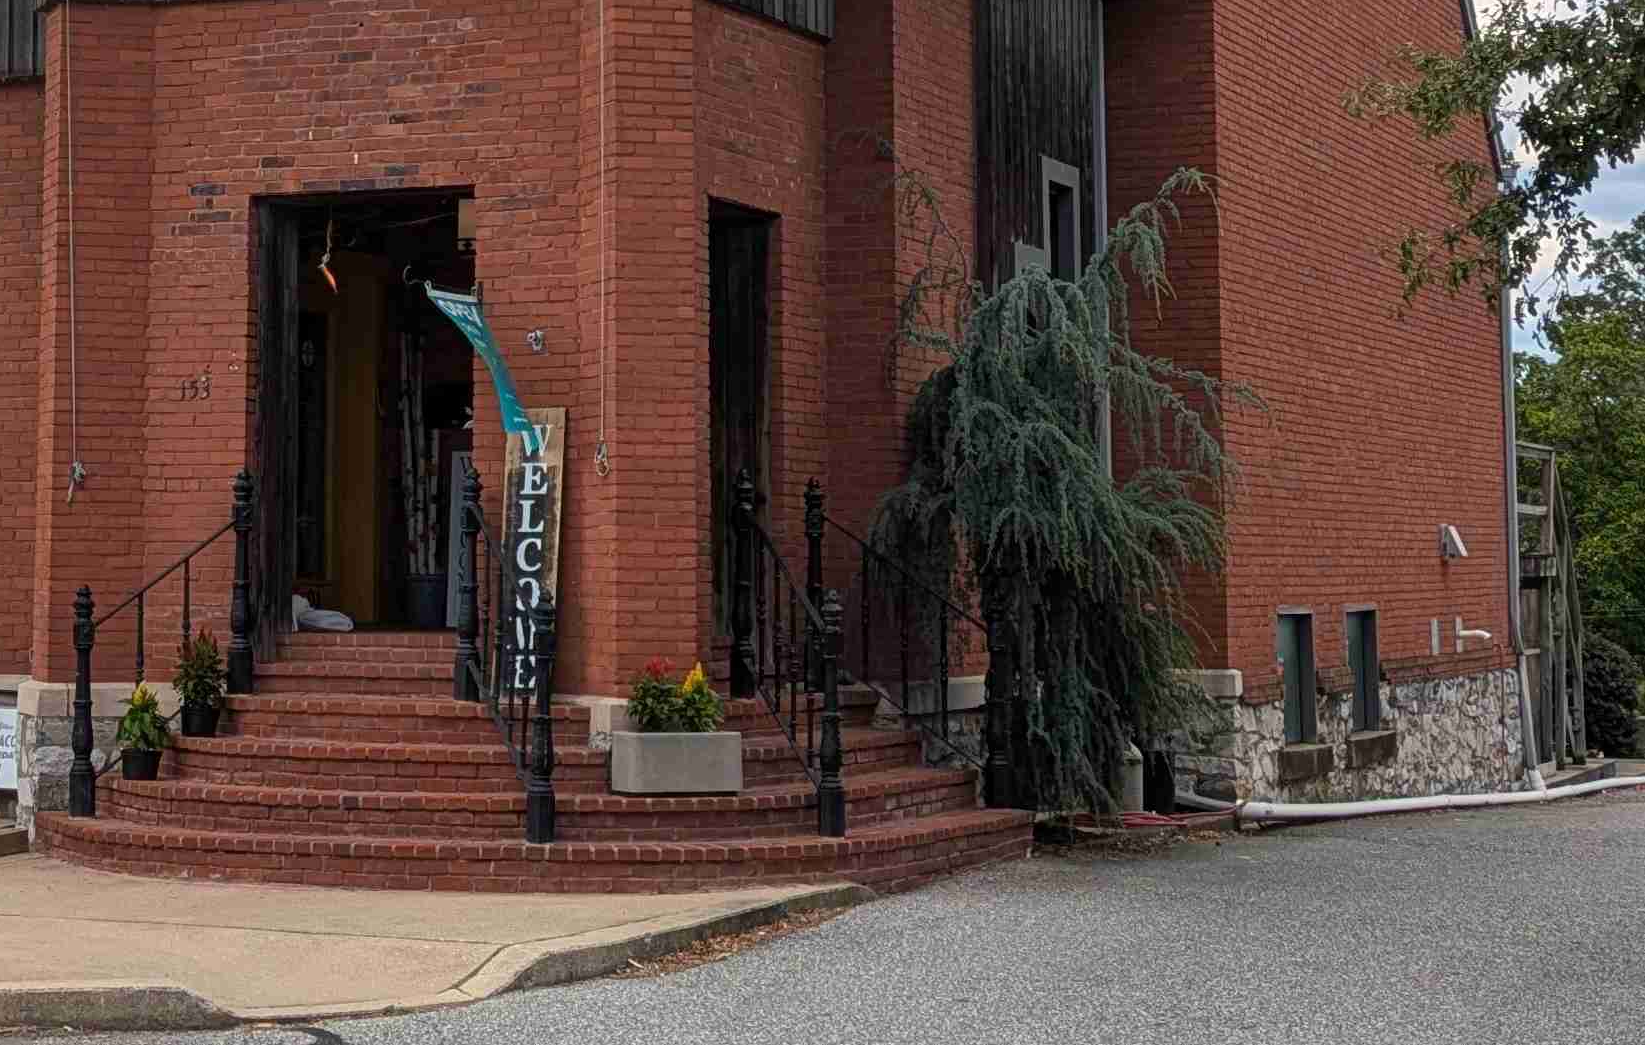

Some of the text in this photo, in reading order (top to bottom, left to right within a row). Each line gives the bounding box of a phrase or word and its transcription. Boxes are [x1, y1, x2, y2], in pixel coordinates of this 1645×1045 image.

[436, 298, 483, 328] OPEN
[180, 379, 211, 402] 153
[507, 424, 553, 689] WELCOME
